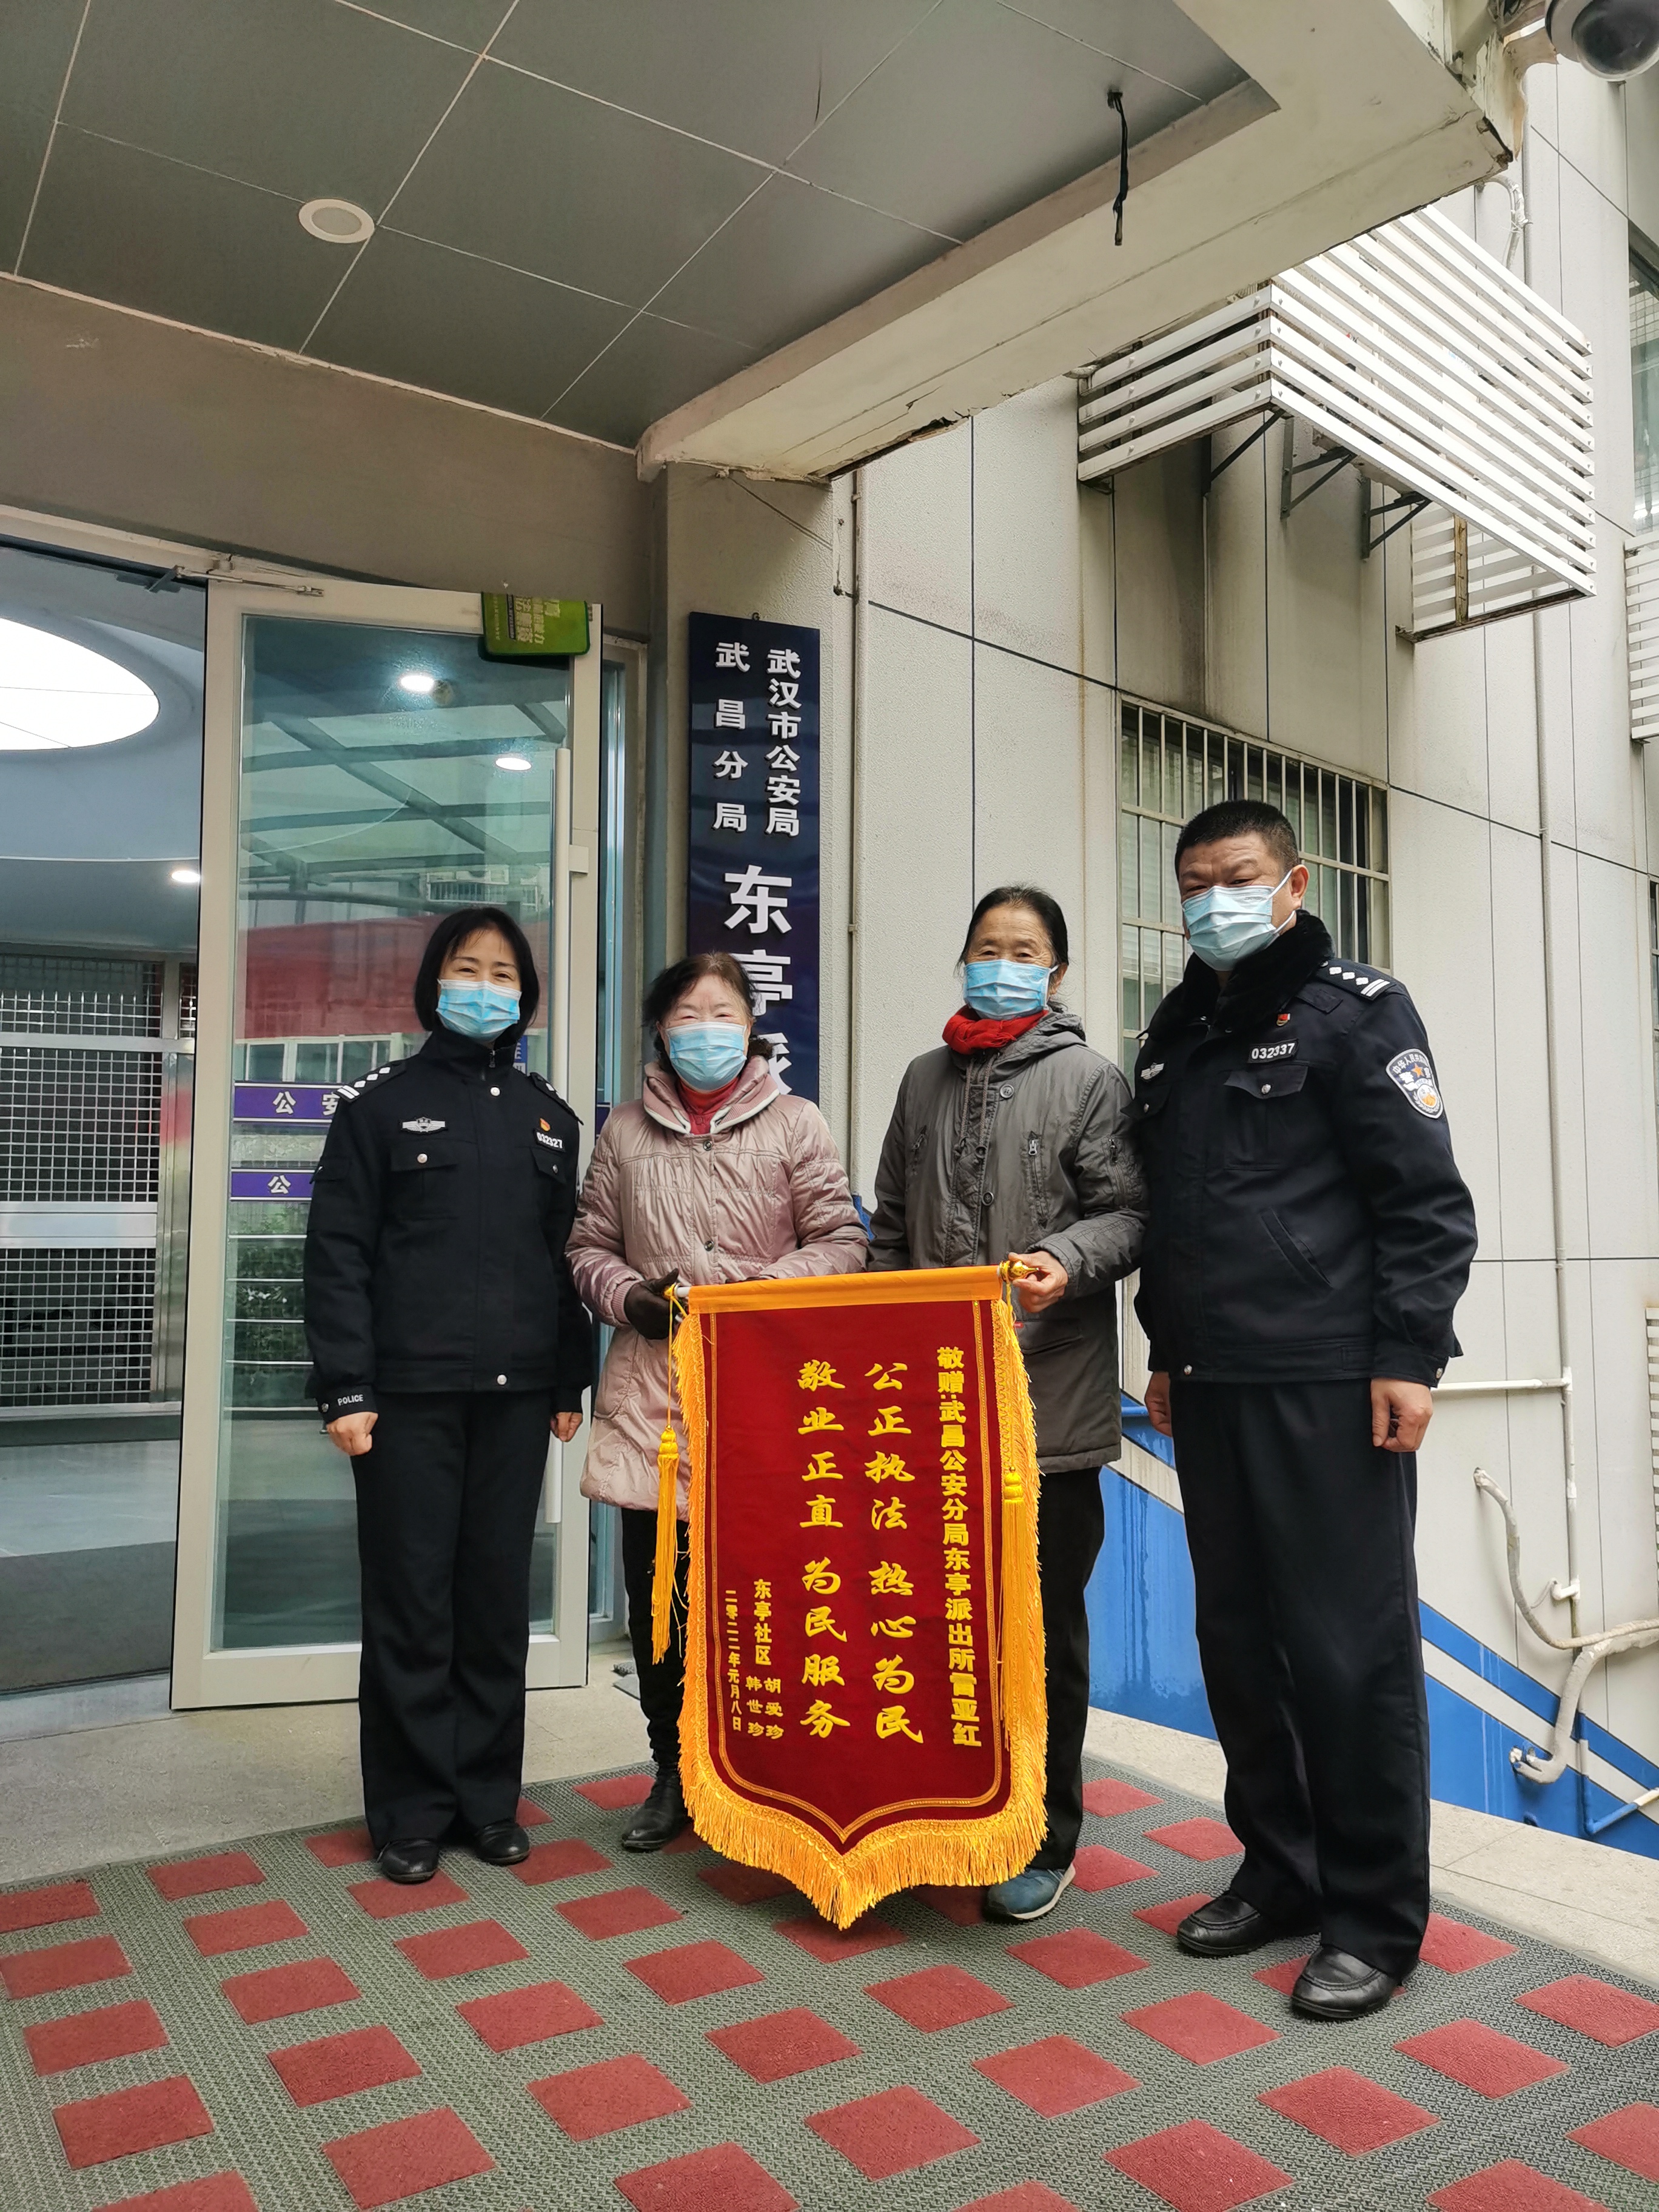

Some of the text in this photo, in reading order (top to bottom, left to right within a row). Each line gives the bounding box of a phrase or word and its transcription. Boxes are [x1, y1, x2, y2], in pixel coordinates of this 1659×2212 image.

[712, 642, 751, 833] 武昌分局
[765, 648, 802, 837] 武汉市公安局
[1252, 1042, 1296, 1059] 032337
[536, 1131, 563, 1148] 032327
[337, 1394, 364, 1406] POLICE
[753, 1578, 773, 1666] 东亭社区
